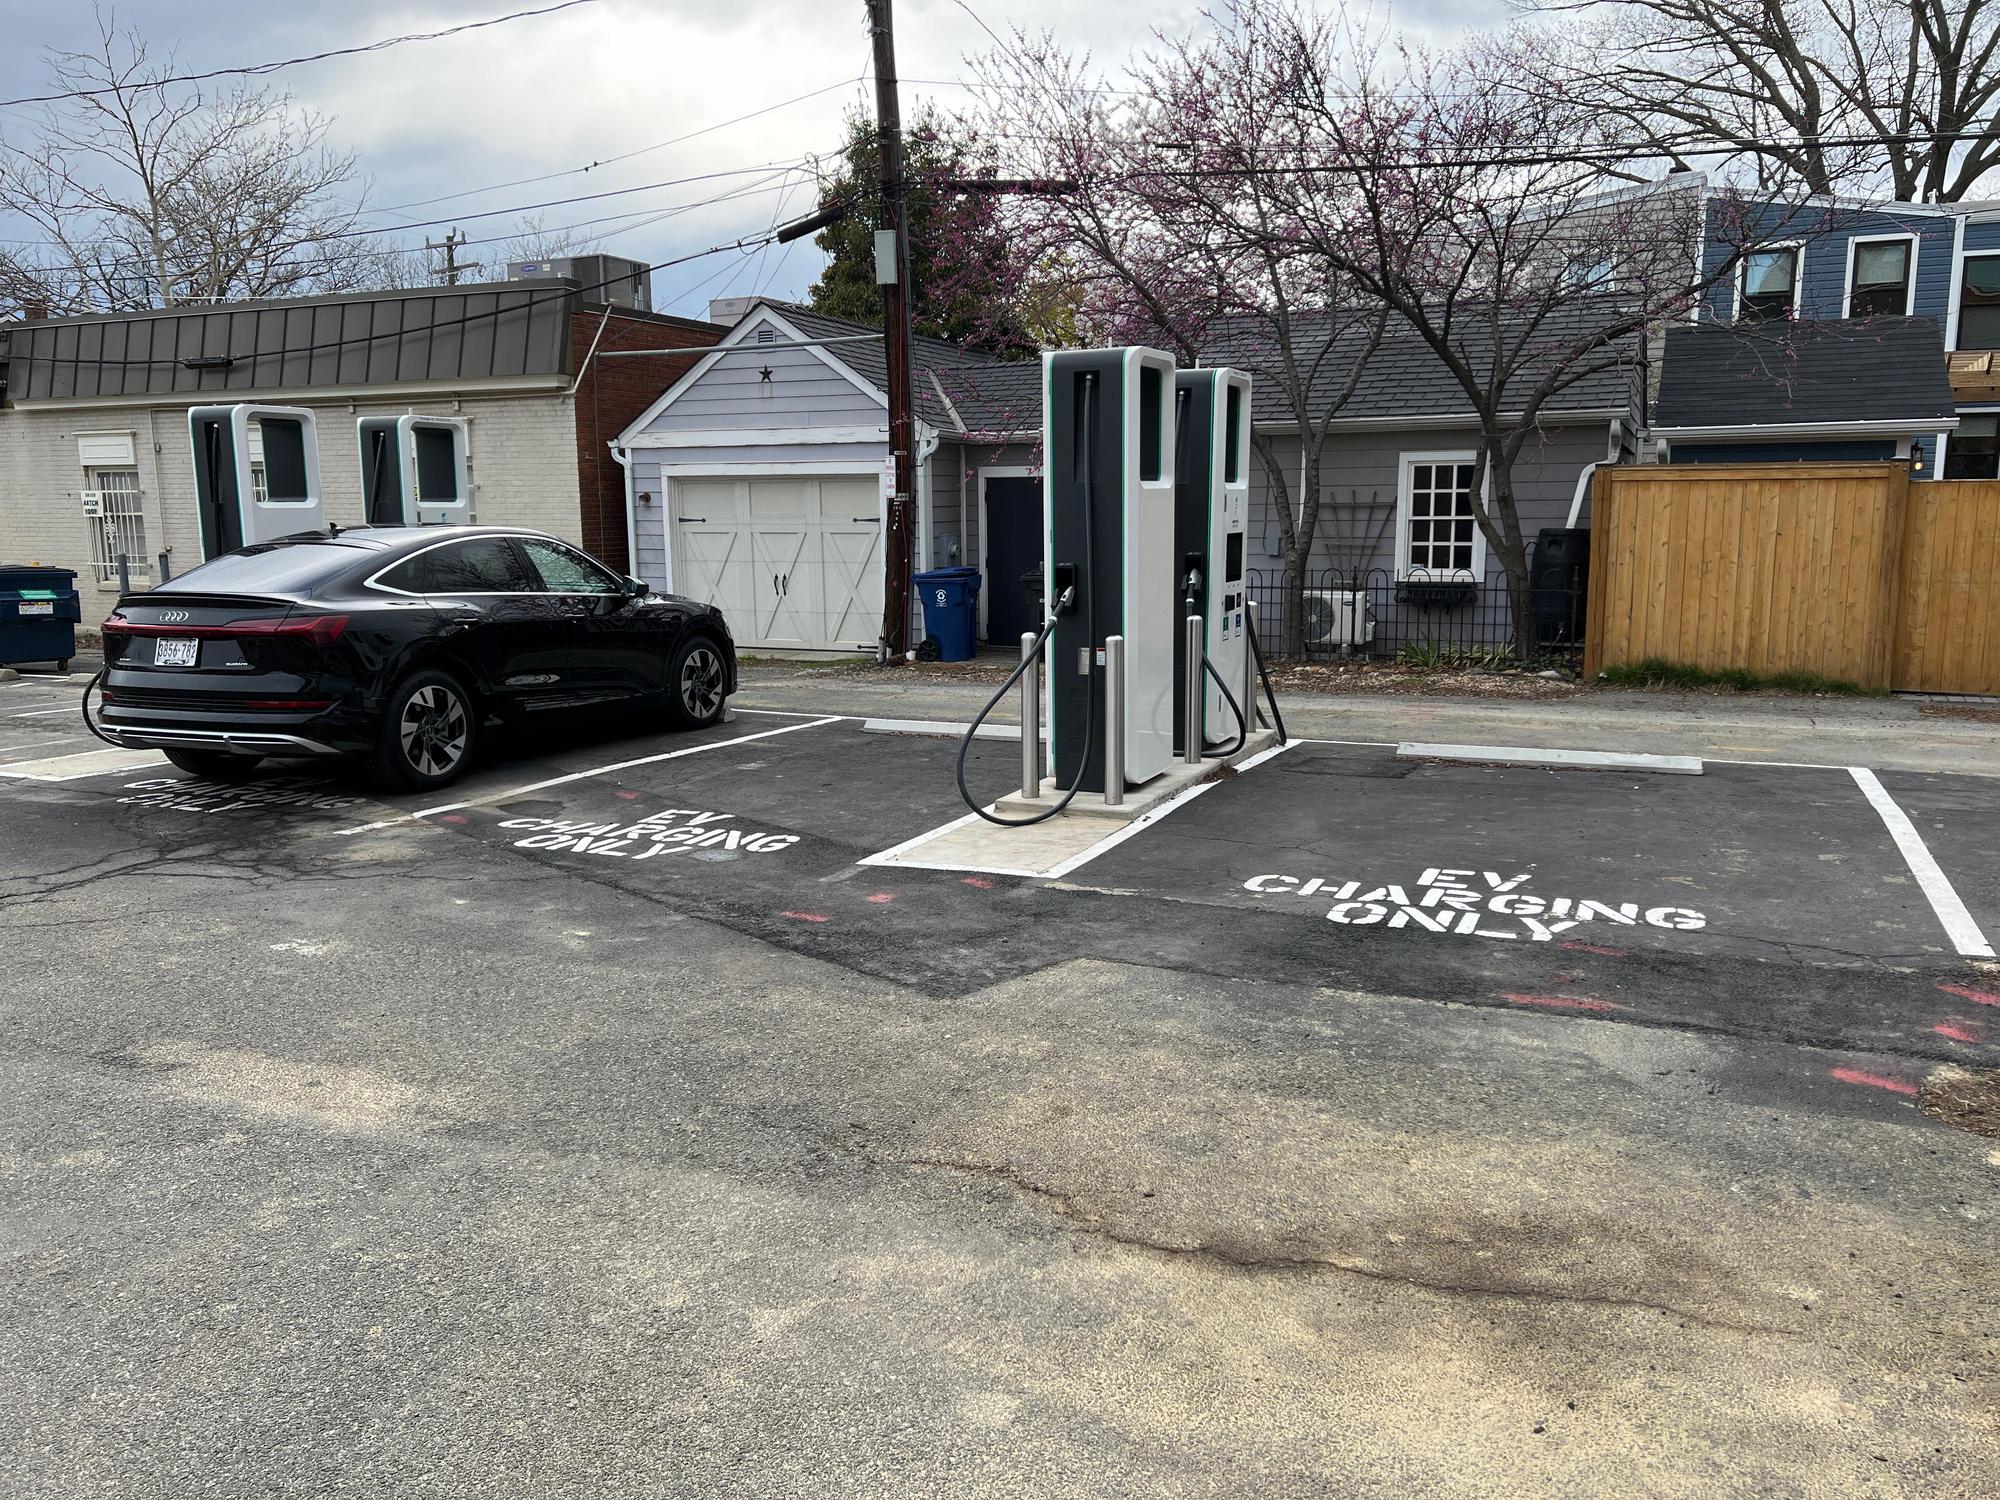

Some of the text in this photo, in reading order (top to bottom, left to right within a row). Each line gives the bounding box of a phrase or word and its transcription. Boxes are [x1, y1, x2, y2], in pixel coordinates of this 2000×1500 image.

[116, 793, 266, 813] ONLY
[637, 809, 736, 825] EV
[498, 818, 800, 852] CHARGING
[513, 834, 692, 859] ONLY
[1416, 867, 1532, 892] EV
[1243, 874, 1707, 930] CHARGING
[1326, 902, 1579, 941] ONLY
